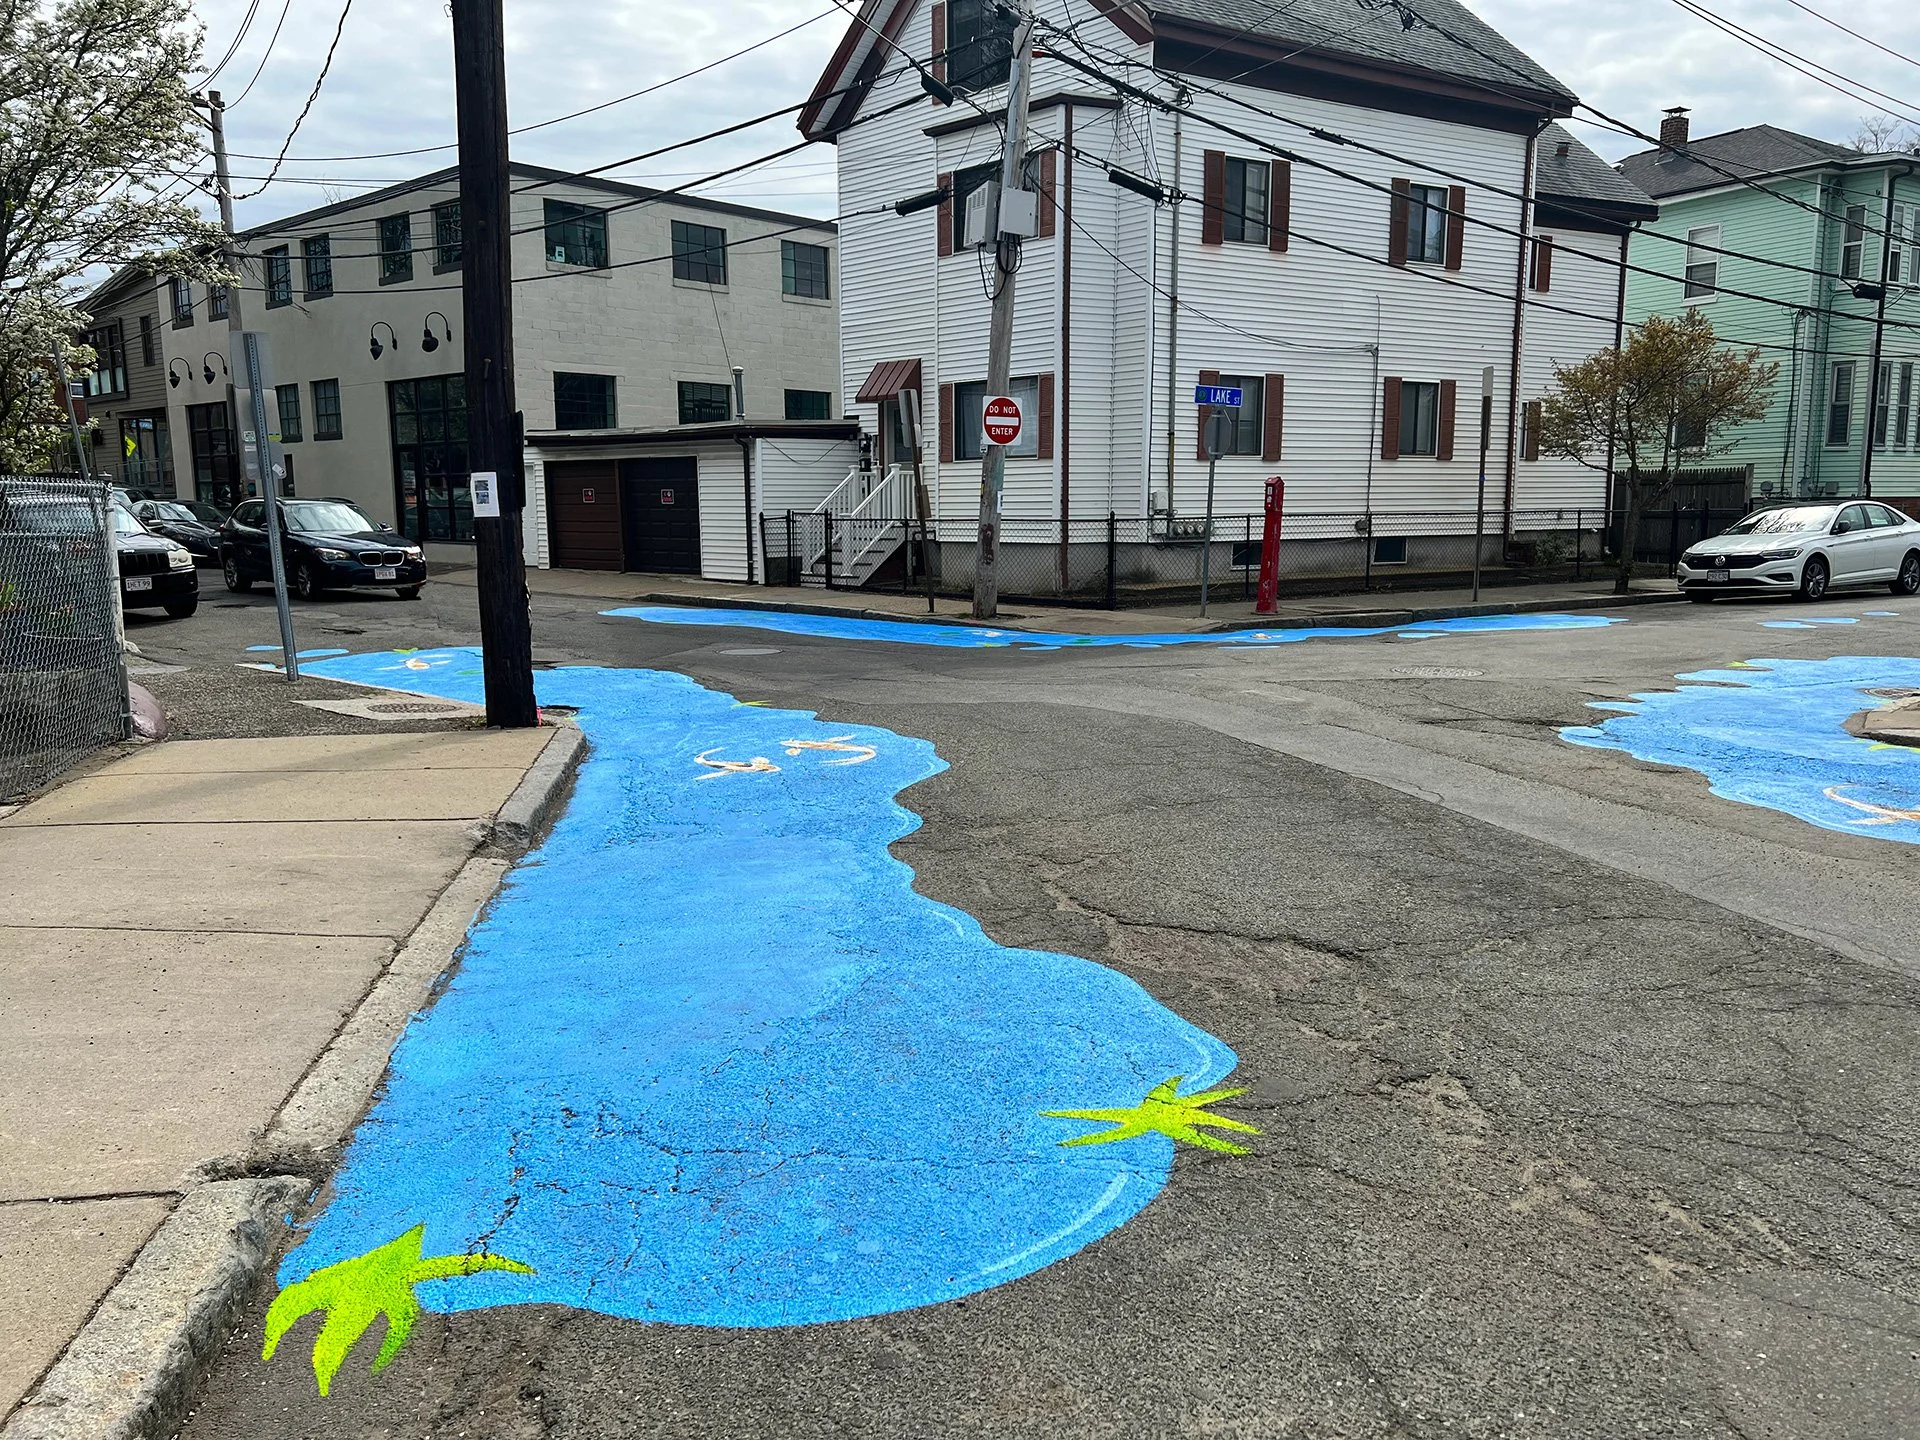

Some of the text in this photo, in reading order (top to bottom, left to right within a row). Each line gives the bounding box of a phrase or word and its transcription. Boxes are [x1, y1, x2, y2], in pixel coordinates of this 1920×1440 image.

[1210, 389, 1241, 405] LAKE ST
[989, 405, 1016, 414] DO NOT
[991, 427, 1013, 436] ENTER
